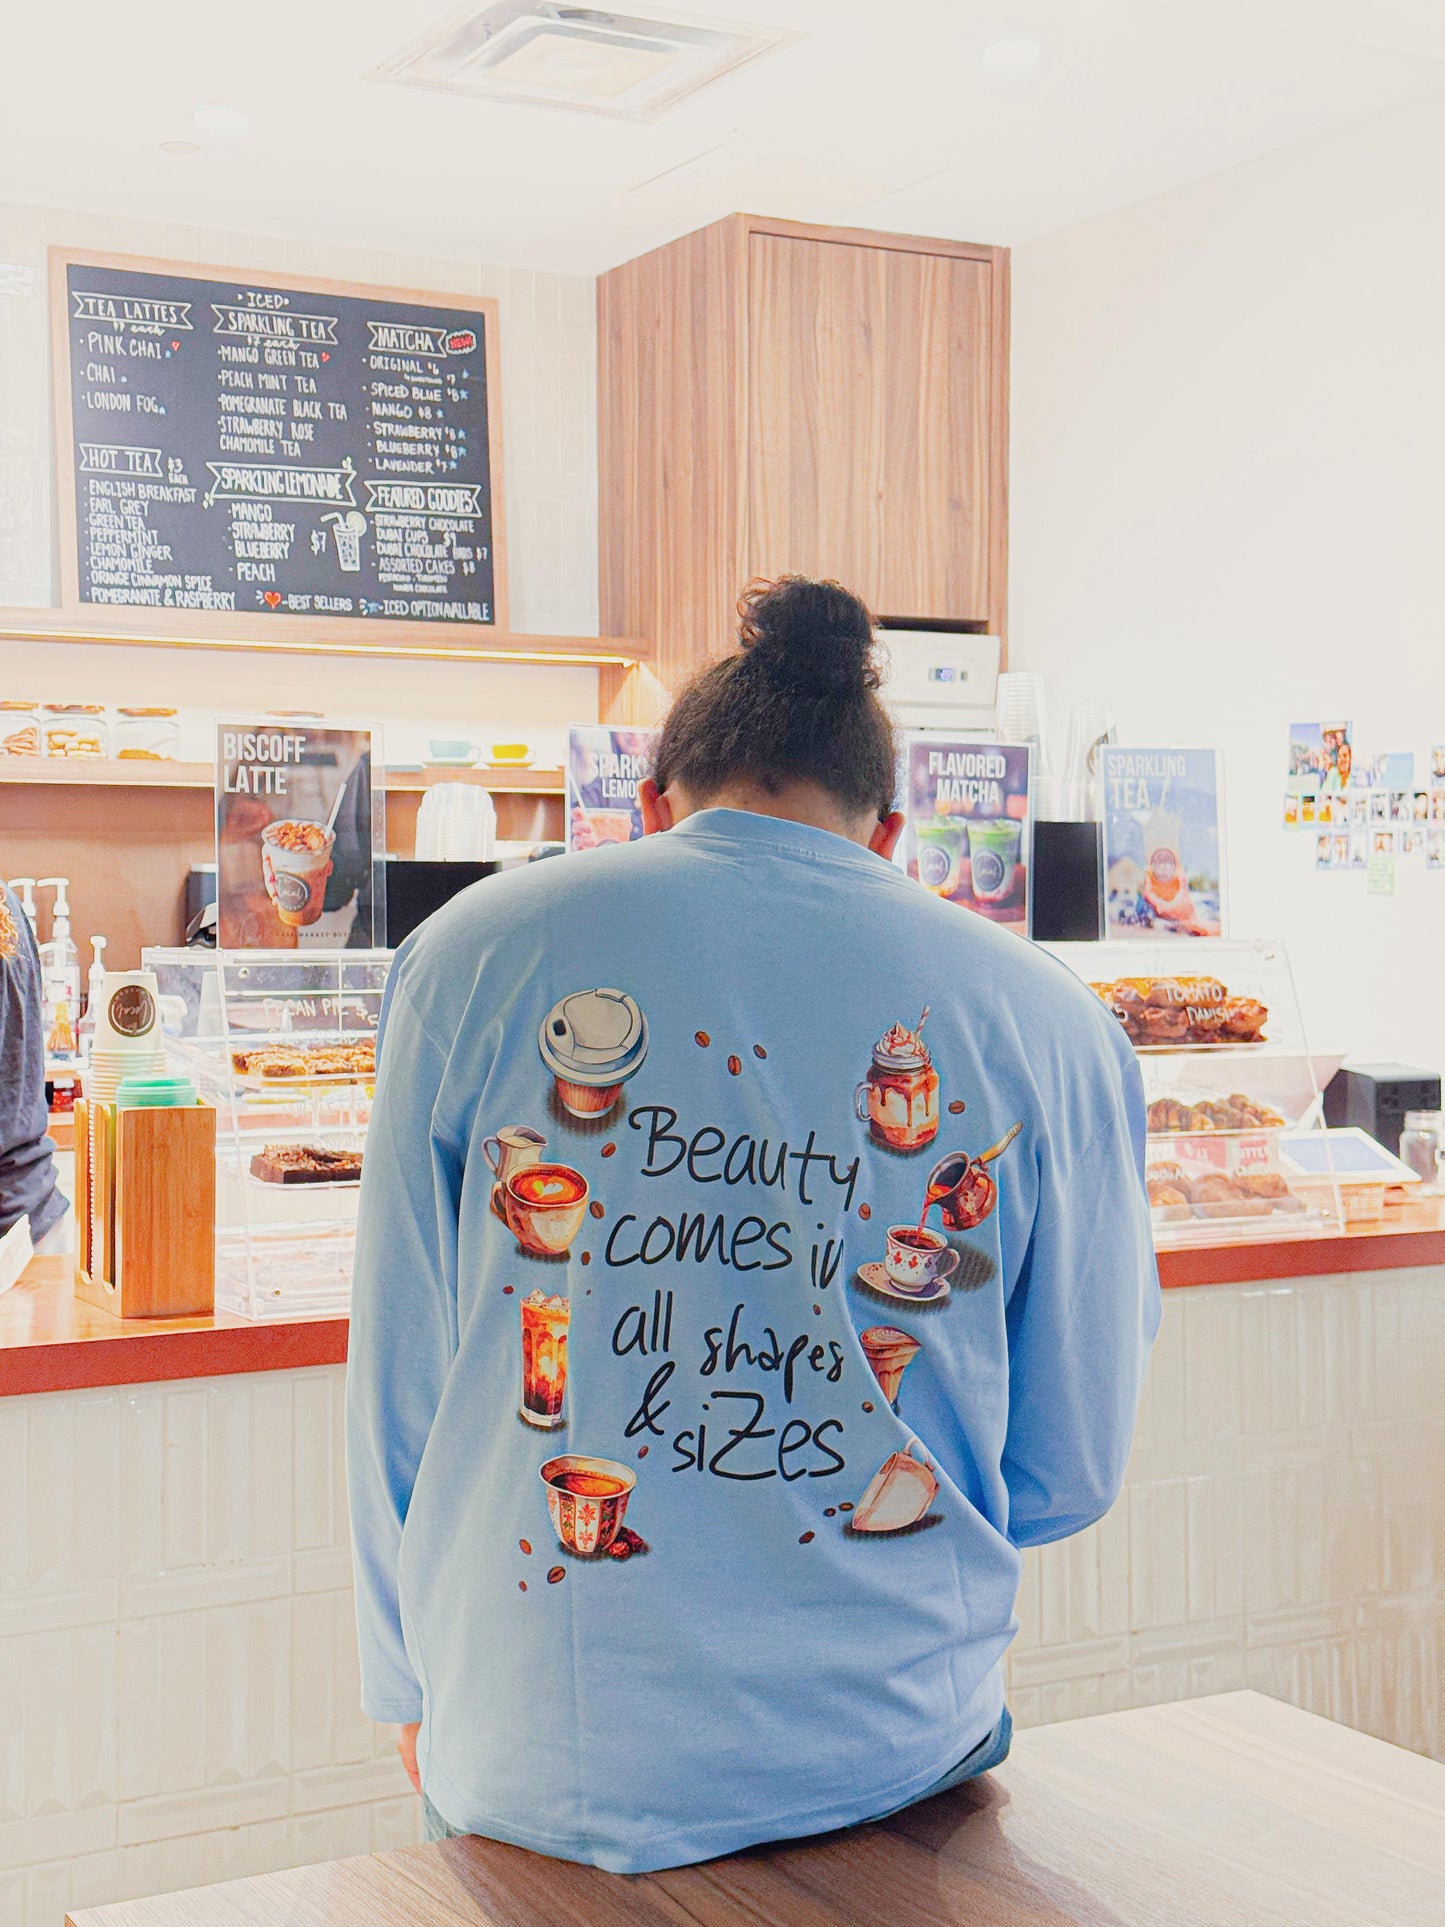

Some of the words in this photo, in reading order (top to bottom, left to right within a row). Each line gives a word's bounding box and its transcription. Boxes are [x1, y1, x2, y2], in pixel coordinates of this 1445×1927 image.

[84, 298, 116, 317] TEA
[124, 302, 178, 323] LATTES
[247, 292, 284, 309] ICED
[229, 312, 294, 336] SPARKLING
[300, 320, 326, 339] TEA
[88, 332, 126, 356] PINK
[130, 340, 161, 359] CHAI
[378, 327, 434, 352] MATCHA
[221, 345, 258, 363] MANGO
[265, 349, 295, 366] GREEN
[300, 352, 319, 369] TEA
[370, 356, 423, 373] ORIGINAL
[87, 363, 116, 383] CHAI
[221, 370, 253, 389] PEACH
[258, 374, 286, 390] MINT
[295, 376, 317, 393] TEA
[87, 392, 131, 412] LONDON
[136, 395, 158, 414] FOG
[371, 383, 408, 399] SPICED
[412, 386, 442, 401] BLUE
[221, 394, 286, 416] POMEGRANATE
[293, 400, 322, 420] BLACK
[328, 402, 347, 421] TEA
[372, 402, 413, 419] MANGO
[220, 416, 283, 438] STRAWBERRY
[291, 422, 314, 441] ROSE
[373, 422, 443, 441] STRAWBERRY
[220, 435, 275, 454] CHAMOMILE
[281, 440, 301, 457] TEA
[376, 440, 440, 457] BLUEBERRY
[89, 448, 118, 469] HOT
[125, 451, 152, 472] TEA
[375, 457, 435, 474] LAVENDER
[89, 479, 136, 497] ENGLISH
[138, 483, 197, 503] BREAKFAST
[221, 468, 284, 495] SPARKLING
[285, 473, 343, 499] LEMONADE
[89, 498, 115, 513] EARL
[120, 499, 149, 517] GREY
[231, 503, 272, 522] MANGO
[89, 513, 124, 528] GREEN
[126, 516, 146, 530] TEA
[232, 522, 296, 543] STRAWBERRY
[89, 527, 158, 545] PEPPERMINT
[311, 529, 327, 555] $7
[90, 542, 126, 557] LEMON
[130, 545, 173, 561] GINGER
[234, 540, 290, 560] BLUEBERRY
[90, 556, 154, 574] CHAMOMILE
[237, 562, 275, 582] PEACH
[380, 558, 423, 573] ASSORTED
[426, 560, 455, 574] CAKES
[90, 571, 130, 585] ORANGE
[184, 575, 213, 592] SPICE
[91, 587, 162, 607] POMEGRANATE
[164, 589, 175, 607] &
[175, 591, 235, 610] RASPBERRY
[288, 594, 312, 610] BEST
[314, 595, 353, 611] SELLERS
[383, 600, 409, 615] ICED
[223, 734, 306, 763] BISCOFF
[929, 752, 1006, 778] FLAVORED
[1108, 754, 1186, 777] SPARKLING
[224, 765, 287, 794] LATTE
[937, 779, 999, 803] MATCHA
[1111, 778, 1150, 809] TEA
[263, 999, 316, 1017] PECAN
[628, 1106, 860, 1211] Beauty
[605, 1212, 793, 1271] comes
[612, 1289, 672, 1356] all
[700, 1304, 844, 1404] shapes
[624, 1361, 675, 1437] &
